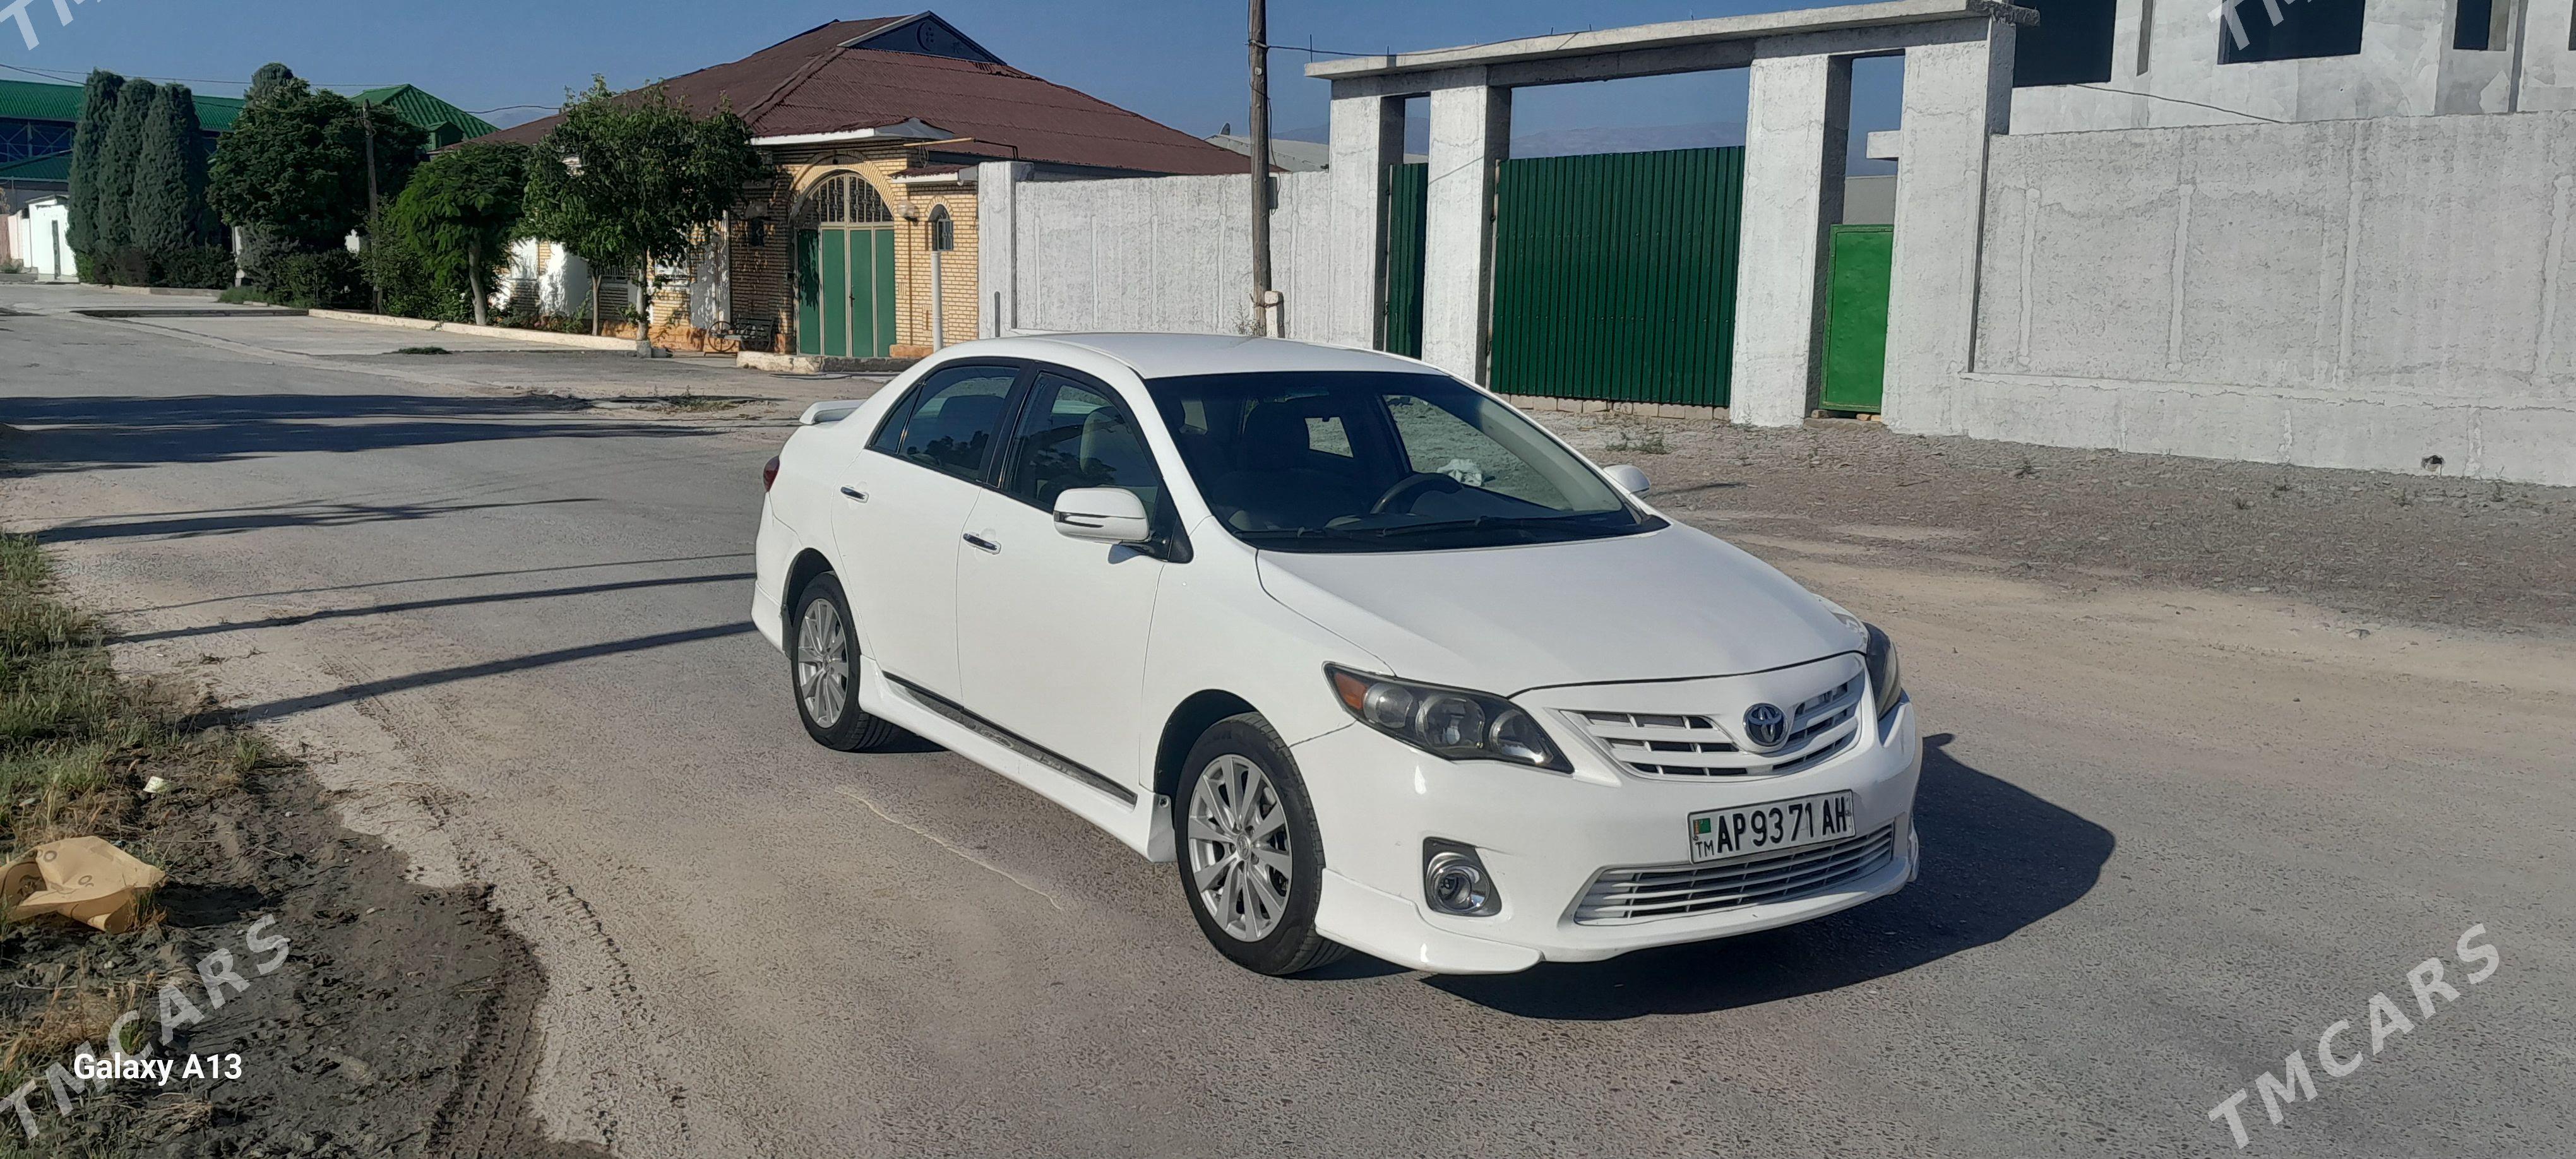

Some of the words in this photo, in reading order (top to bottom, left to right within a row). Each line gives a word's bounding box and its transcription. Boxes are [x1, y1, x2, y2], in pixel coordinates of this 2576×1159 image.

[1717, 802, 1814, 853] AP9371
[1822, 796, 1847, 836] AH
[1695, 839, 1715, 858] TM
